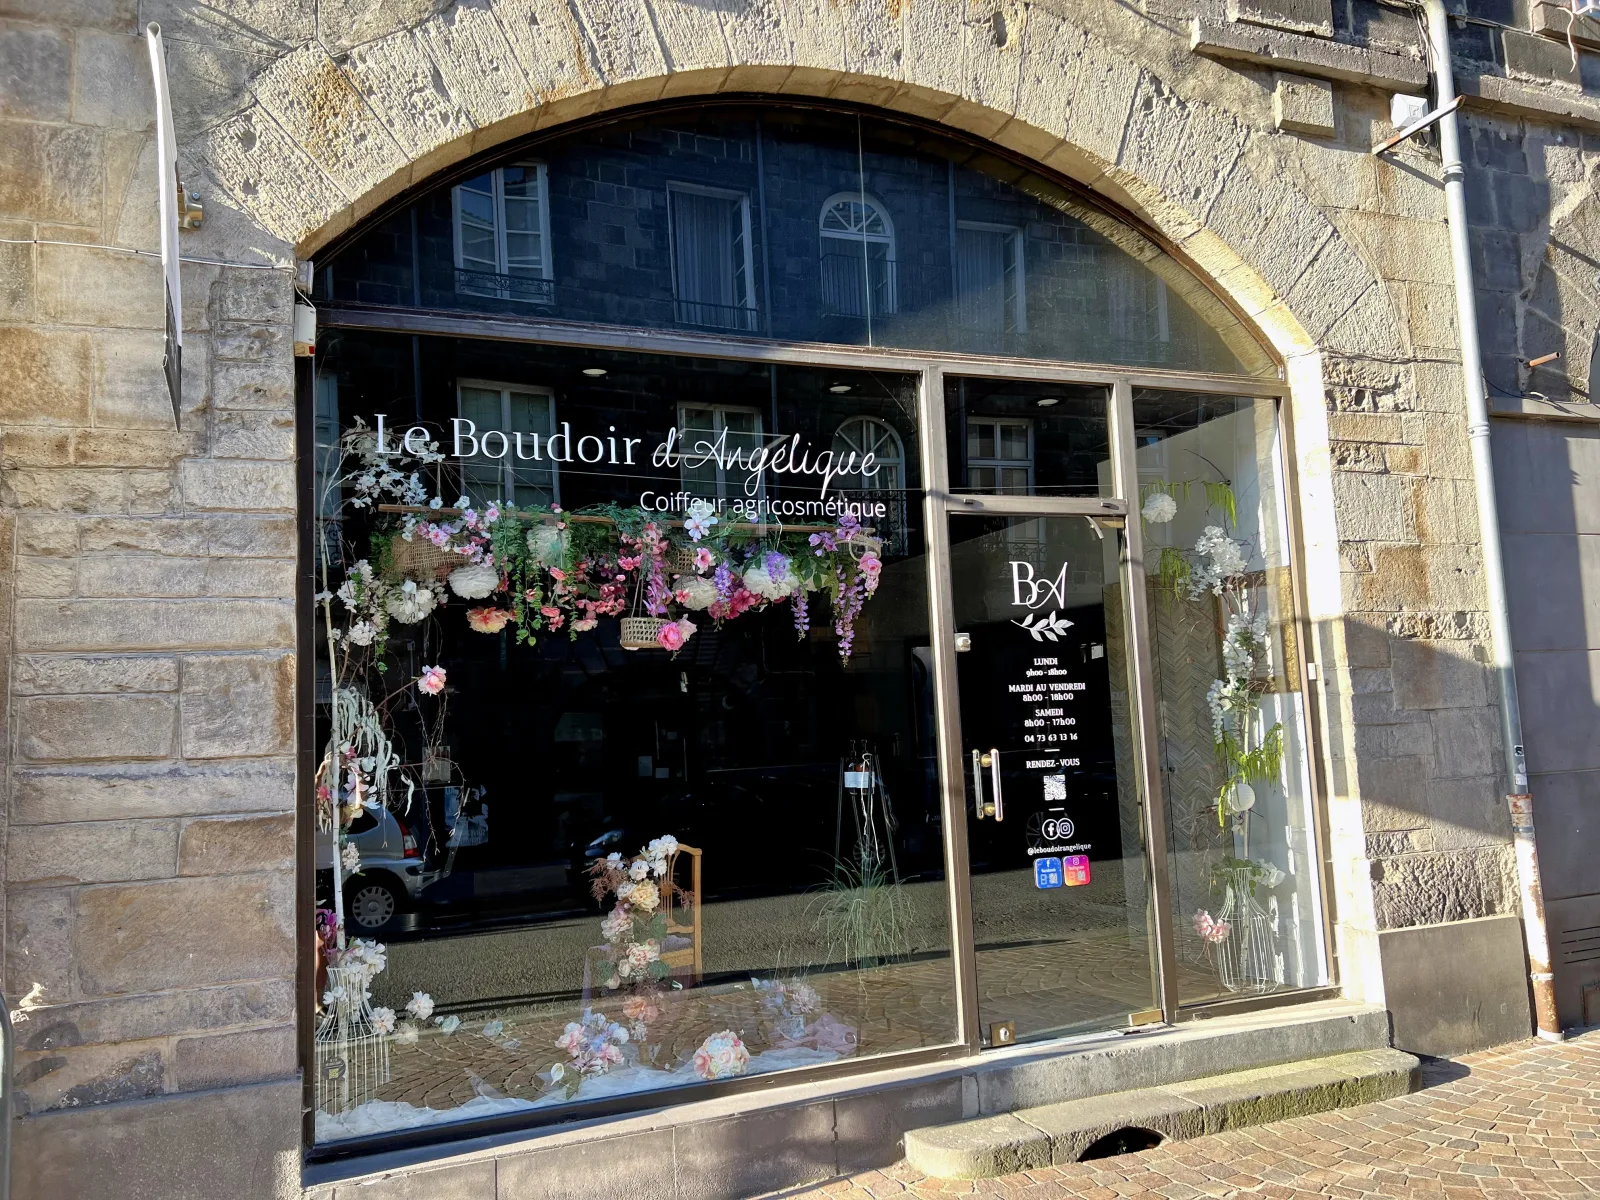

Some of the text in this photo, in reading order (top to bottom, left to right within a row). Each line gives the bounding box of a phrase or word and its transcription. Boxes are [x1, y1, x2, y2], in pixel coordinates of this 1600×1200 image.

[373, 413, 431, 455] Le
[450, 417, 642, 466] Boudoir
[640, 491, 887, 523] Coiffeur agricosmétique
[1033, 657, 1058, 666] LUNDI
[1008, 682, 1086, 692] MARDI AU VENDREDI
[1022, 693, 1043, 702] 8h00
[1050, 692, 1074, 701] 18h00
[1035, 708, 1064, 717] SAMEDI
[1024, 718, 1045, 728] 8h00
[1052, 717, 1076, 726] 17h00
[1024, 732, 1078, 742] 04 73 63 13 16
